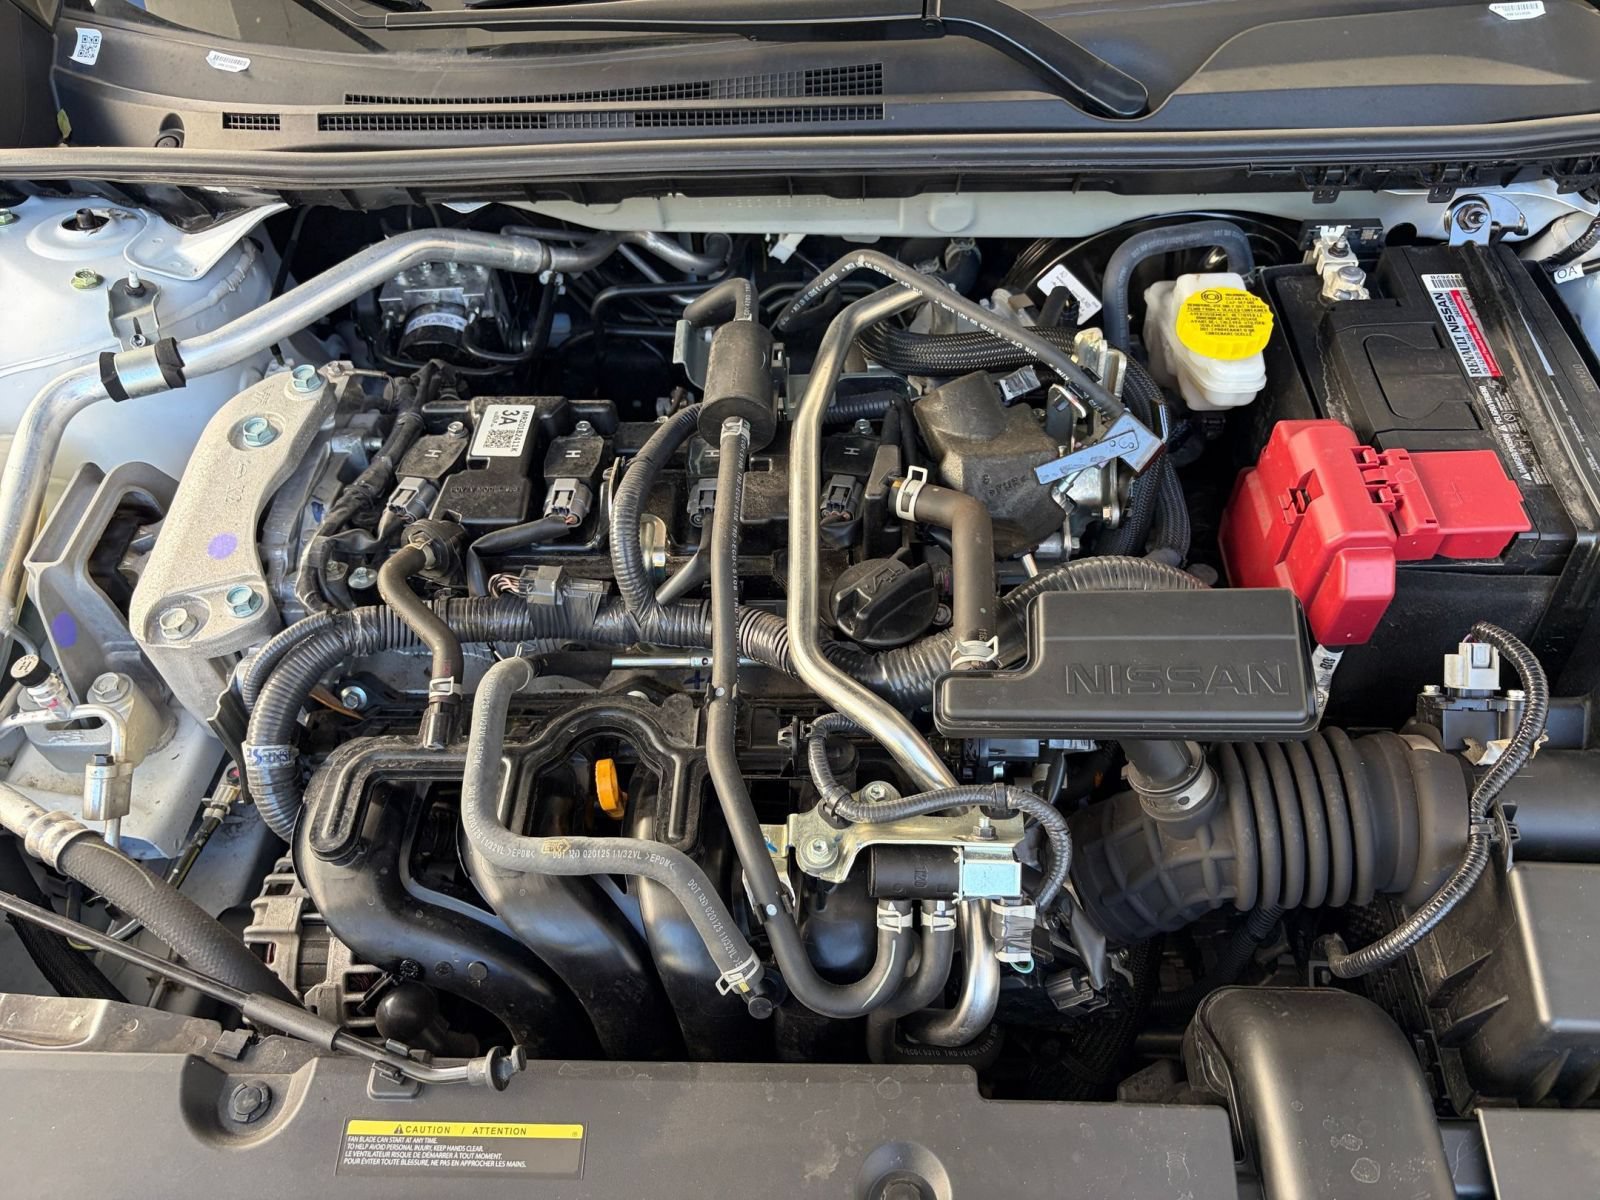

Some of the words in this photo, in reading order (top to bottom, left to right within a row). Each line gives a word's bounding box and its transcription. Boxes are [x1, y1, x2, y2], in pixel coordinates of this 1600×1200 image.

[1432, 292, 1461, 333] NISSAN
[1453, 335, 1482, 374] RENAULT
[498, 408, 521, 427] 3A
[1063, 663, 1292, 697] NISSAN
[405, 1124, 451, 1135] CAUTION
[472, 1126, 527, 1137] ATTENTION
[389, 1136, 405, 1144] START
[381, 1158, 400, 1166] TOUTE
[439, 1159, 450, 1167] PAS
[459, 1160, 495, 1168] APPROCHER
[495, 1160, 506, 1168] LES
[390, 1151, 412, 1159] RISQUE
[459, 1152, 475, 1160] TOUT
